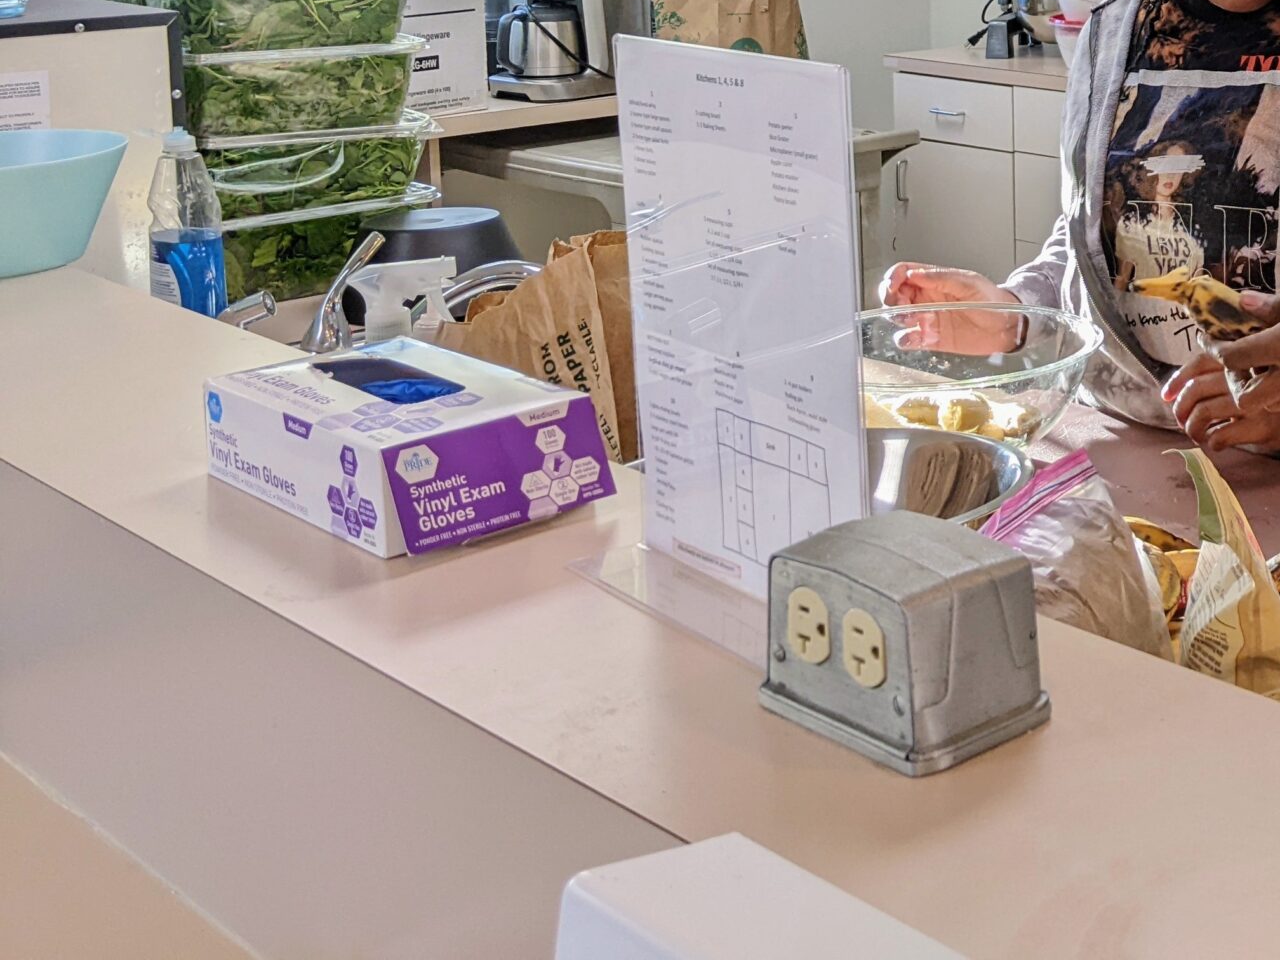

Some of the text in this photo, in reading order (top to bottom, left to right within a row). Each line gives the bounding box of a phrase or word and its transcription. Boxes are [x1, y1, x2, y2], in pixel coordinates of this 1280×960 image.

[696, 73, 717, 84] Kitchens
[1138, 312, 1168, 326] know
[540, 342, 562, 386] ROM
[556, 330, 592, 394] PAPER
[288, 419, 307, 435] Medium
[528, 408, 560, 422] Medium
[209, 422, 238, 448] Synthetic
[542, 428, 557, 439] 100
[210, 440, 297, 497] Vinyl Exam Gloves
[410, 474, 468, 498] Synthetic
[413, 480, 506, 516] Vinyl Exam
[418, 506, 476, 532] Gloves
[420, 534, 440, 546] POWDER
[440, 530, 453, 540] FREE
[456, 527, 467, 536] NON
[509, 510, 521, 519] FREE
